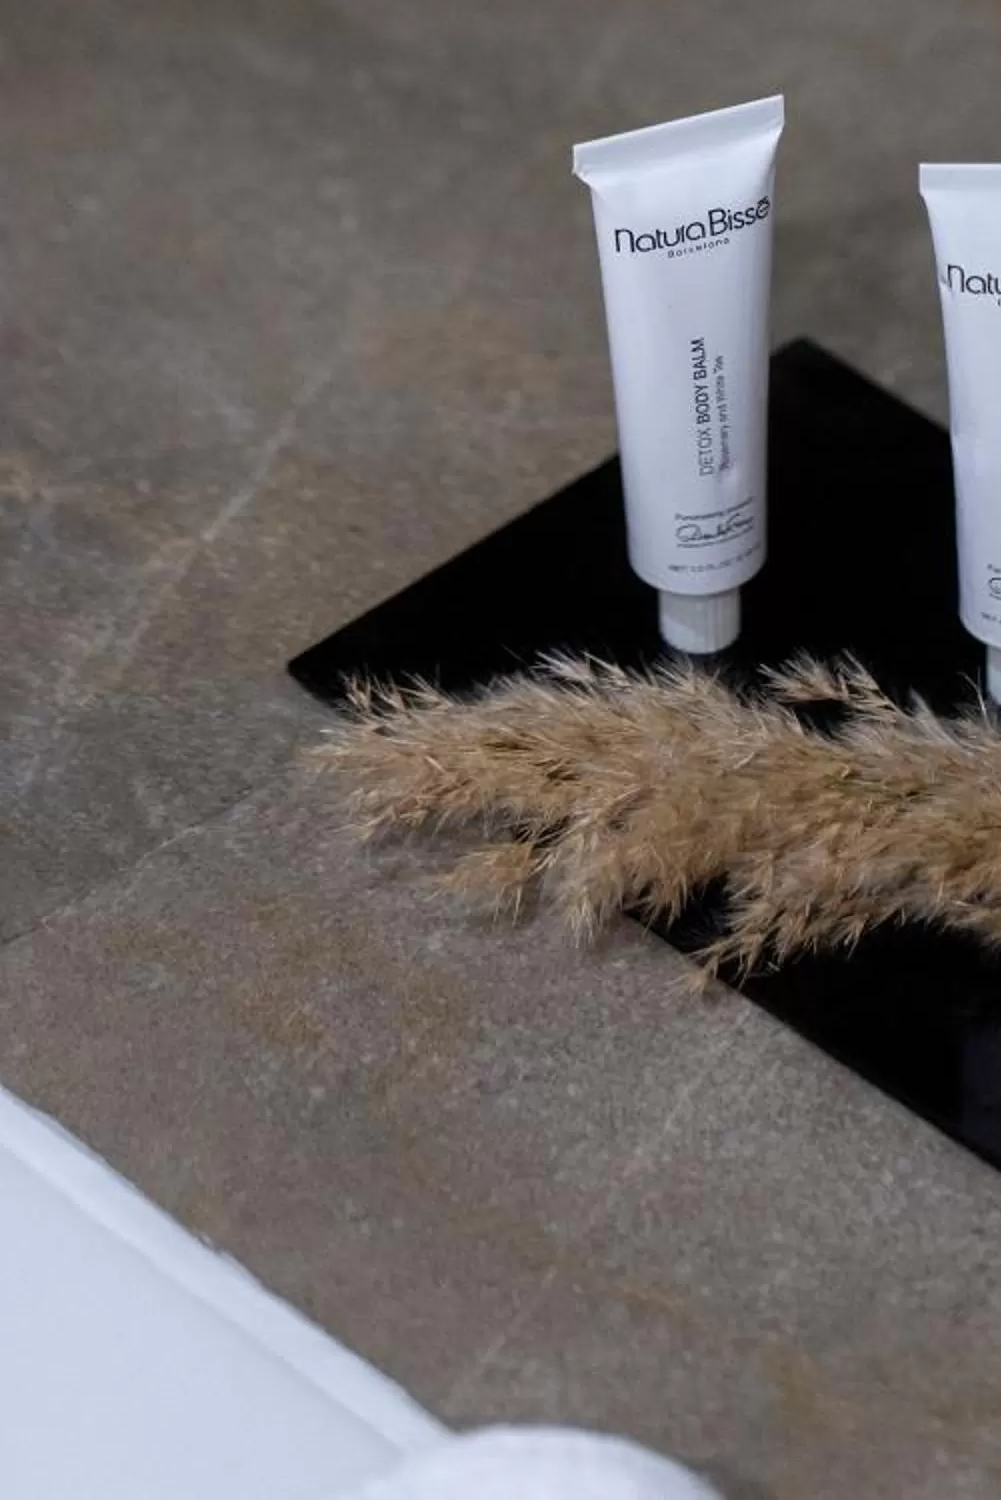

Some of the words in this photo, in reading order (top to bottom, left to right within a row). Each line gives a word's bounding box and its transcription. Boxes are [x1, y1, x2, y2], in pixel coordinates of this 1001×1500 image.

[690, 336, 707, 381] BALM
[694, 384, 711, 425] BODY
[696, 428, 714, 477] DETOX
